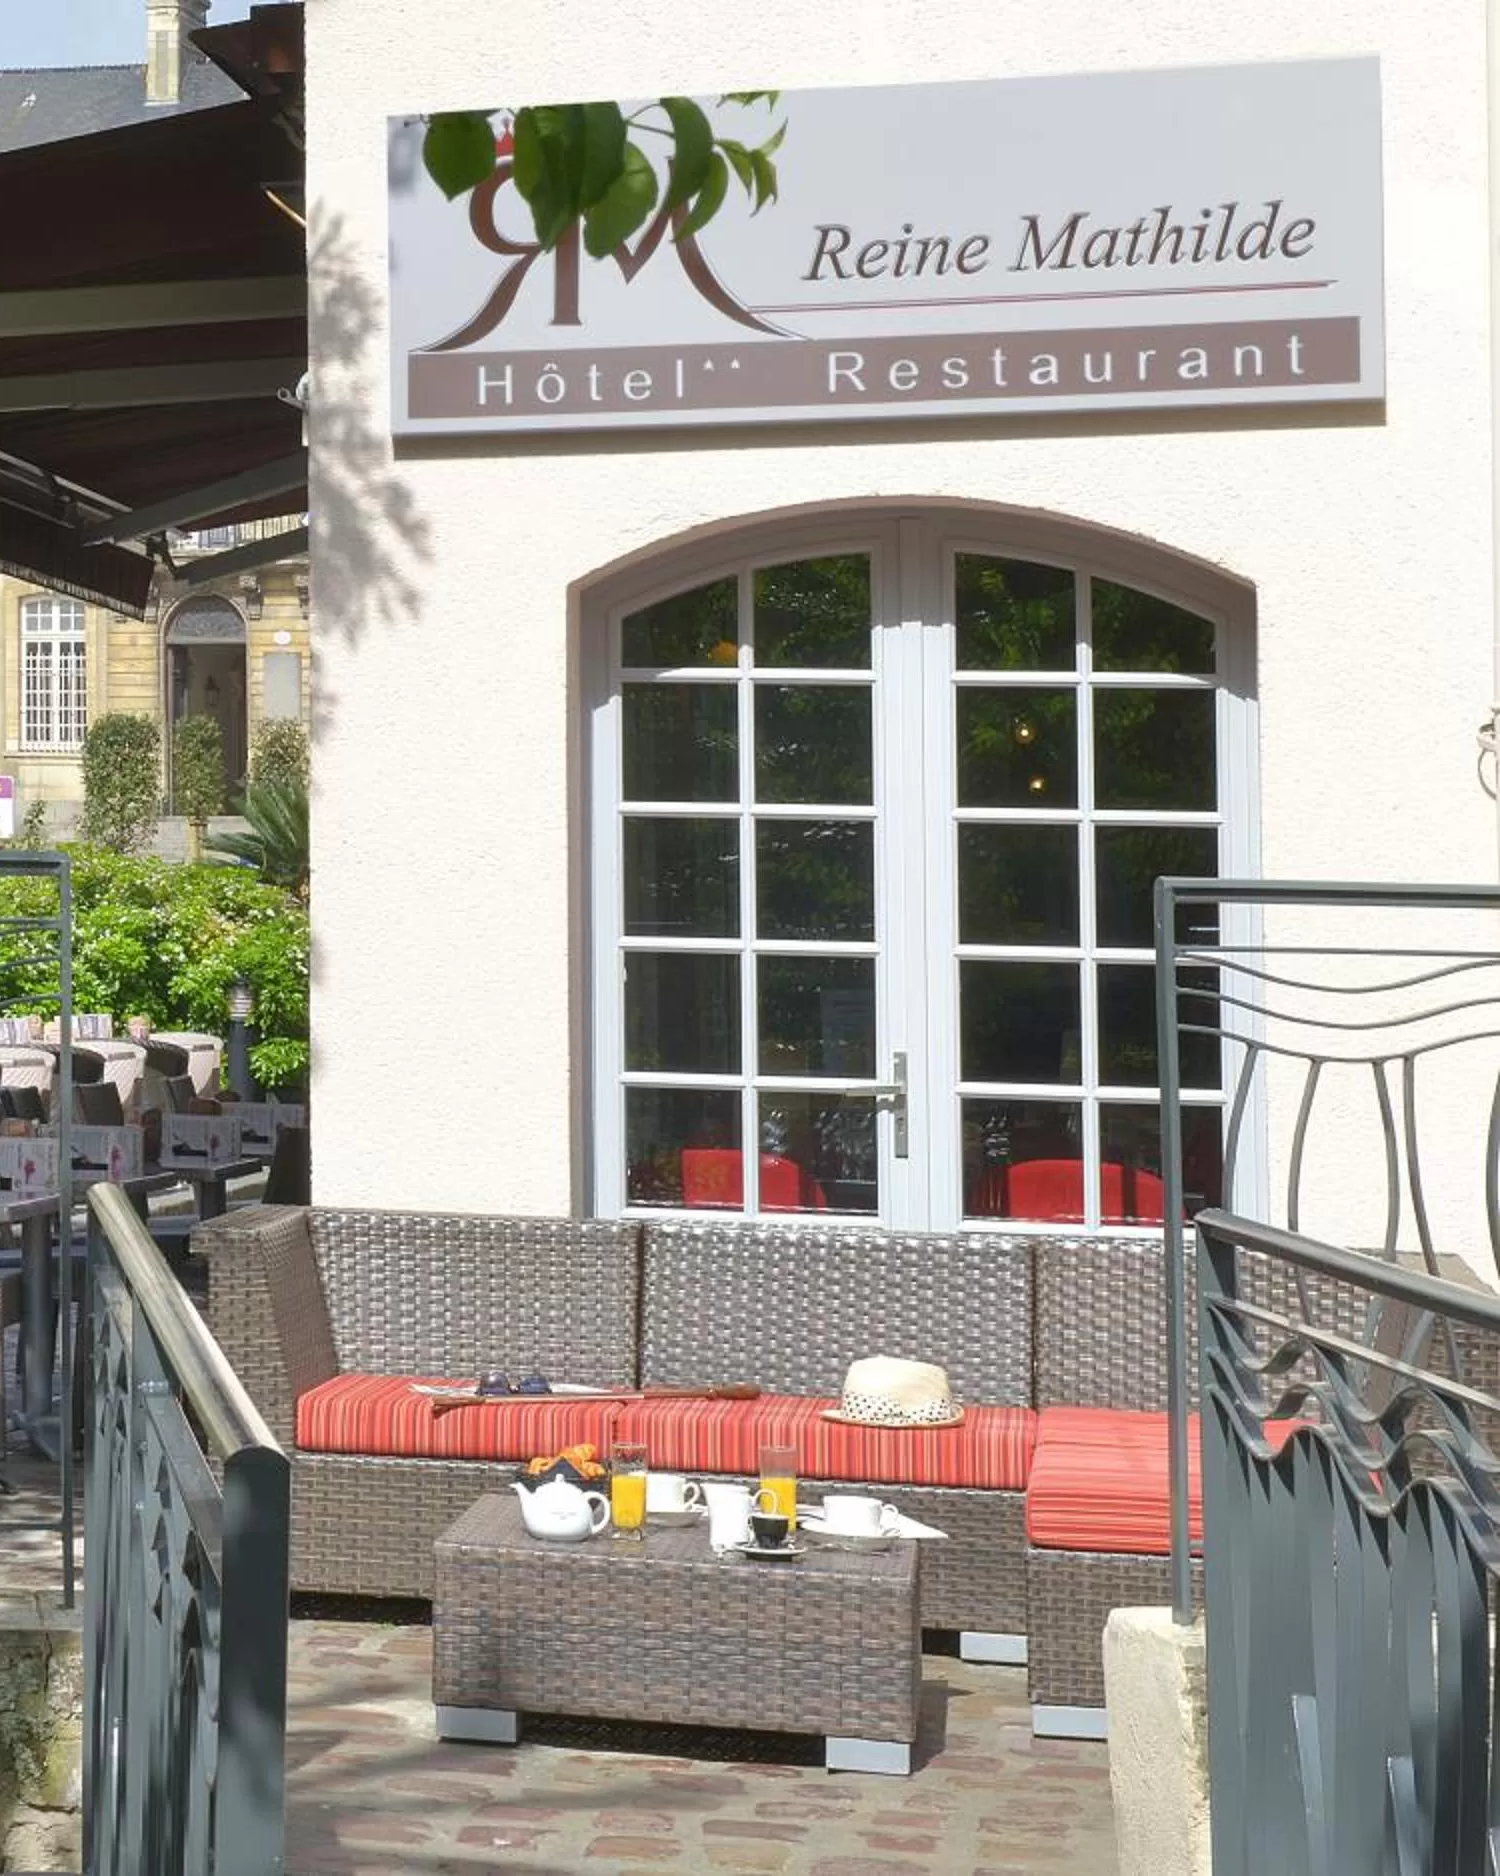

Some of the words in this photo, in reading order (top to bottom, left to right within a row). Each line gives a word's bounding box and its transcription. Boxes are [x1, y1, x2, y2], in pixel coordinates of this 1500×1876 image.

[801, 221, 990, 281] Reine
[1006, 199, 1317, 273] Mathilde
[478, 357, 684, 405] Hôtel
[827, 334, 1305, 392] Restaurant
